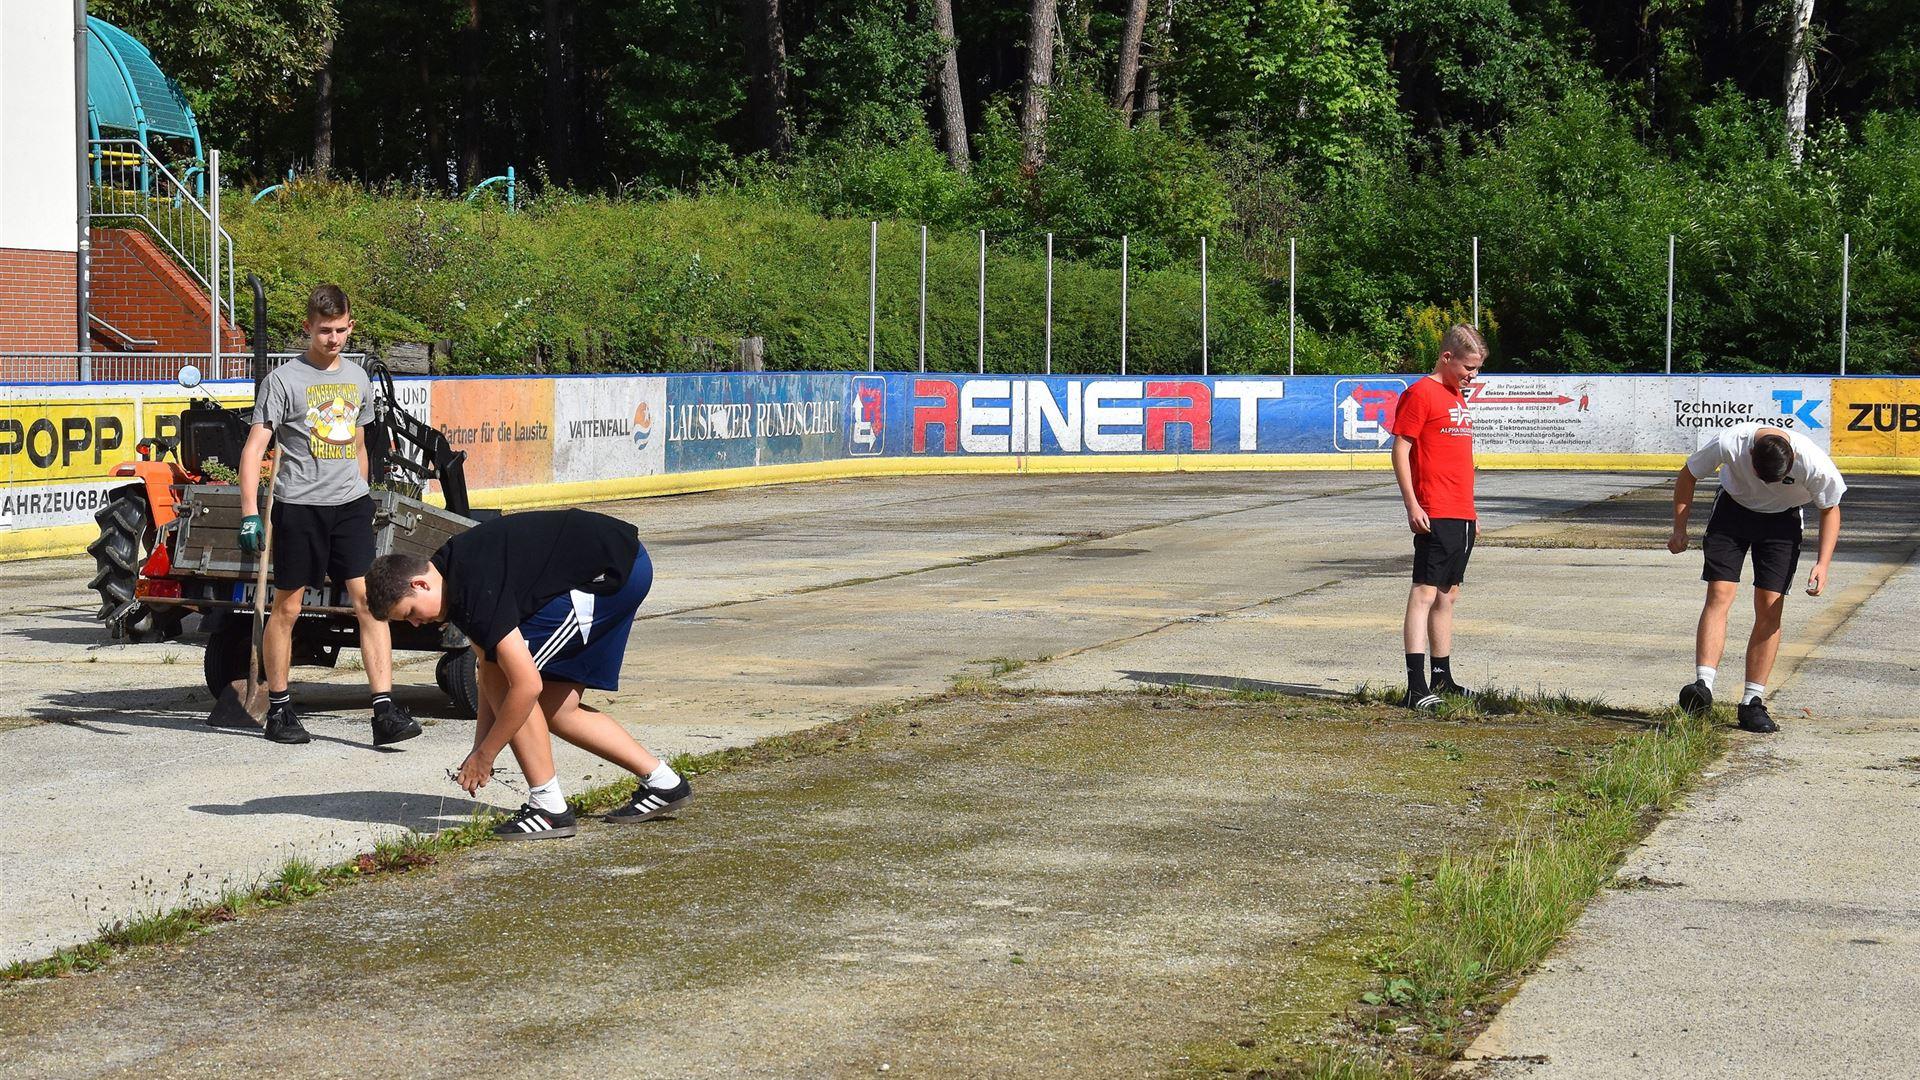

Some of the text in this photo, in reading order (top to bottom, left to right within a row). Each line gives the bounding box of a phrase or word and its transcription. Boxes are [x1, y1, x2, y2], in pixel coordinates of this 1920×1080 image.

[402, 387, 428, 405] UND
[1674, 399, 1754, 414] Techniker
[756, 400, 840, 438] RUNDSCHAU
[911, 379, 1284, 453] REINERT
[1675, 412, 1795, 428] Krankenkasse
[1772, 389, 1824, 429] TK
[440, 420, 548, 445] Partner für die Lausitz
[569, 418, 631, 439] VATTENFALL
[310, 435, 343, 459] DRINK
